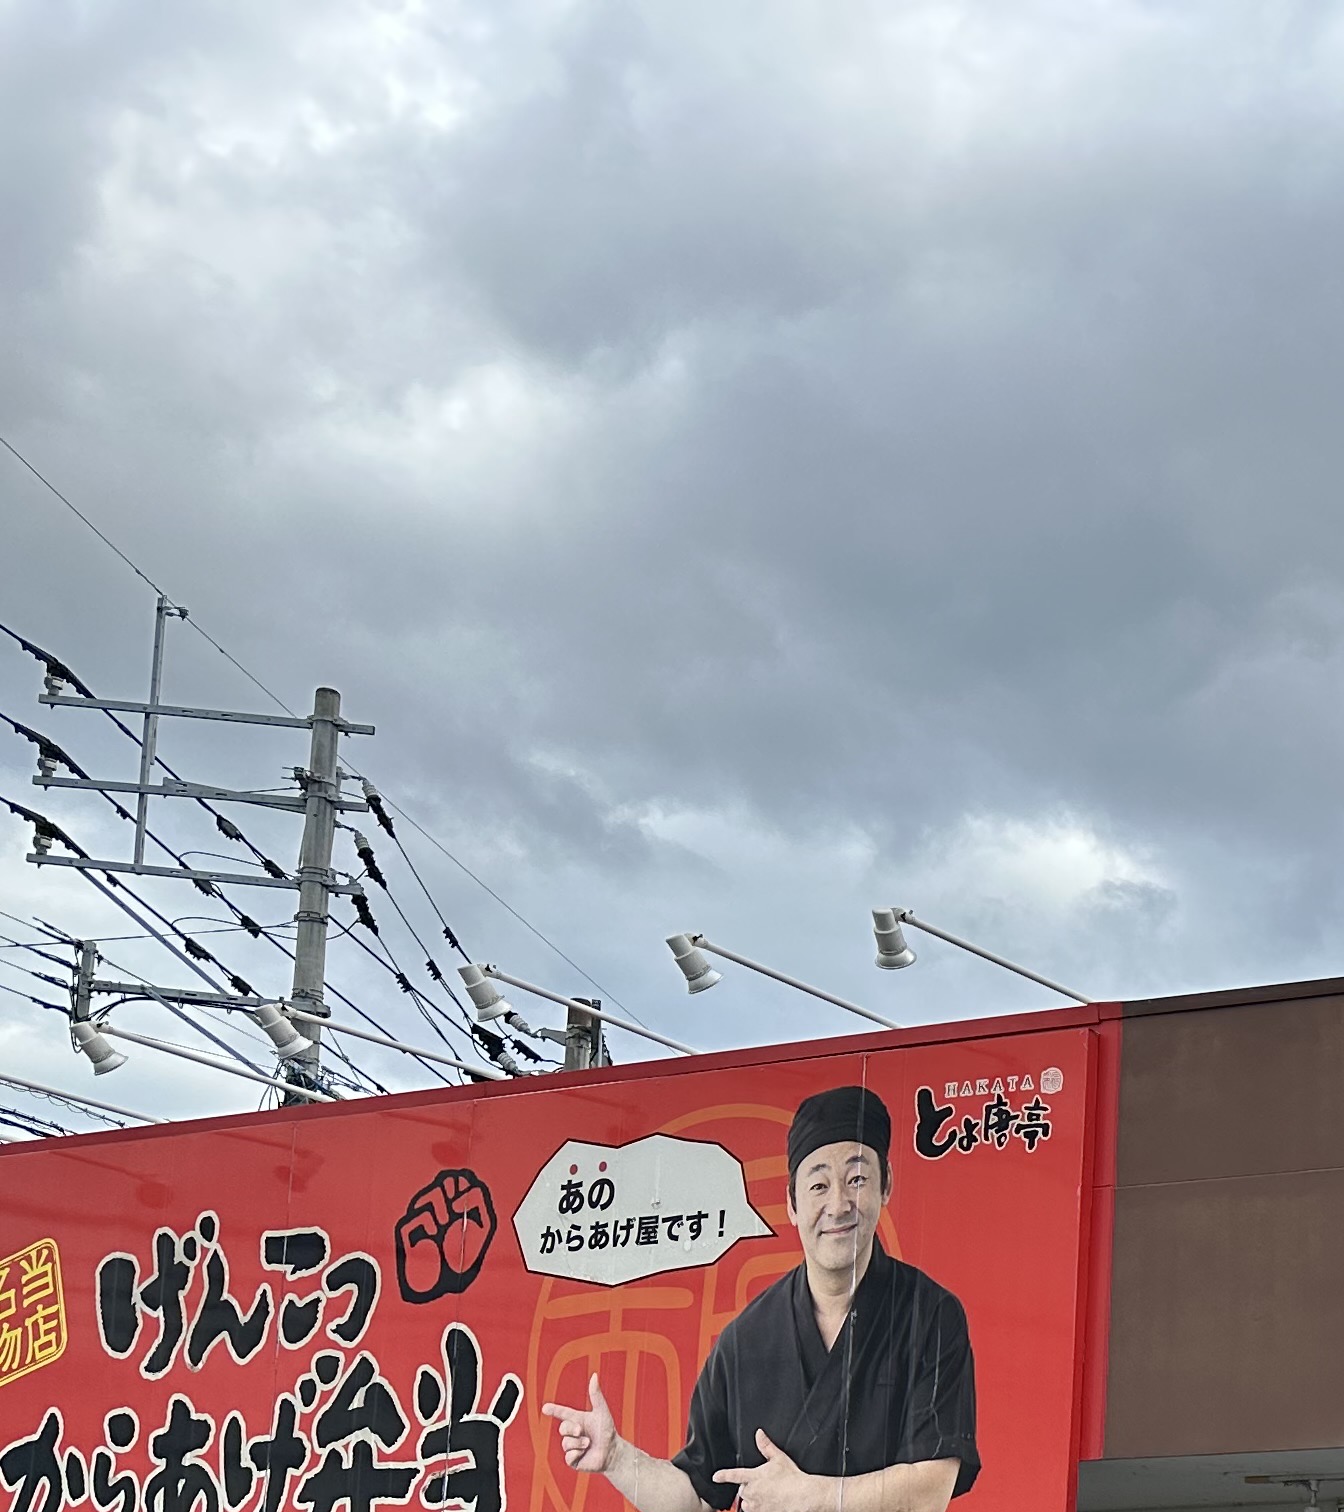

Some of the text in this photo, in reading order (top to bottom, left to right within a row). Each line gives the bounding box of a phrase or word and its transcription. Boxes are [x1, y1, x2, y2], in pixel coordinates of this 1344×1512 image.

[945, 1074, 1034, 1098] HAKATA
[914, 1086, 1051, 1160] とよ唐亭
[558, 1177, 615, 1215] あの
[539, 1210, 726, 1254] からあげ屋です！
[20, 1248, 60, 1364] 当店
[96, 1211, 380, 1379] げんこつ
